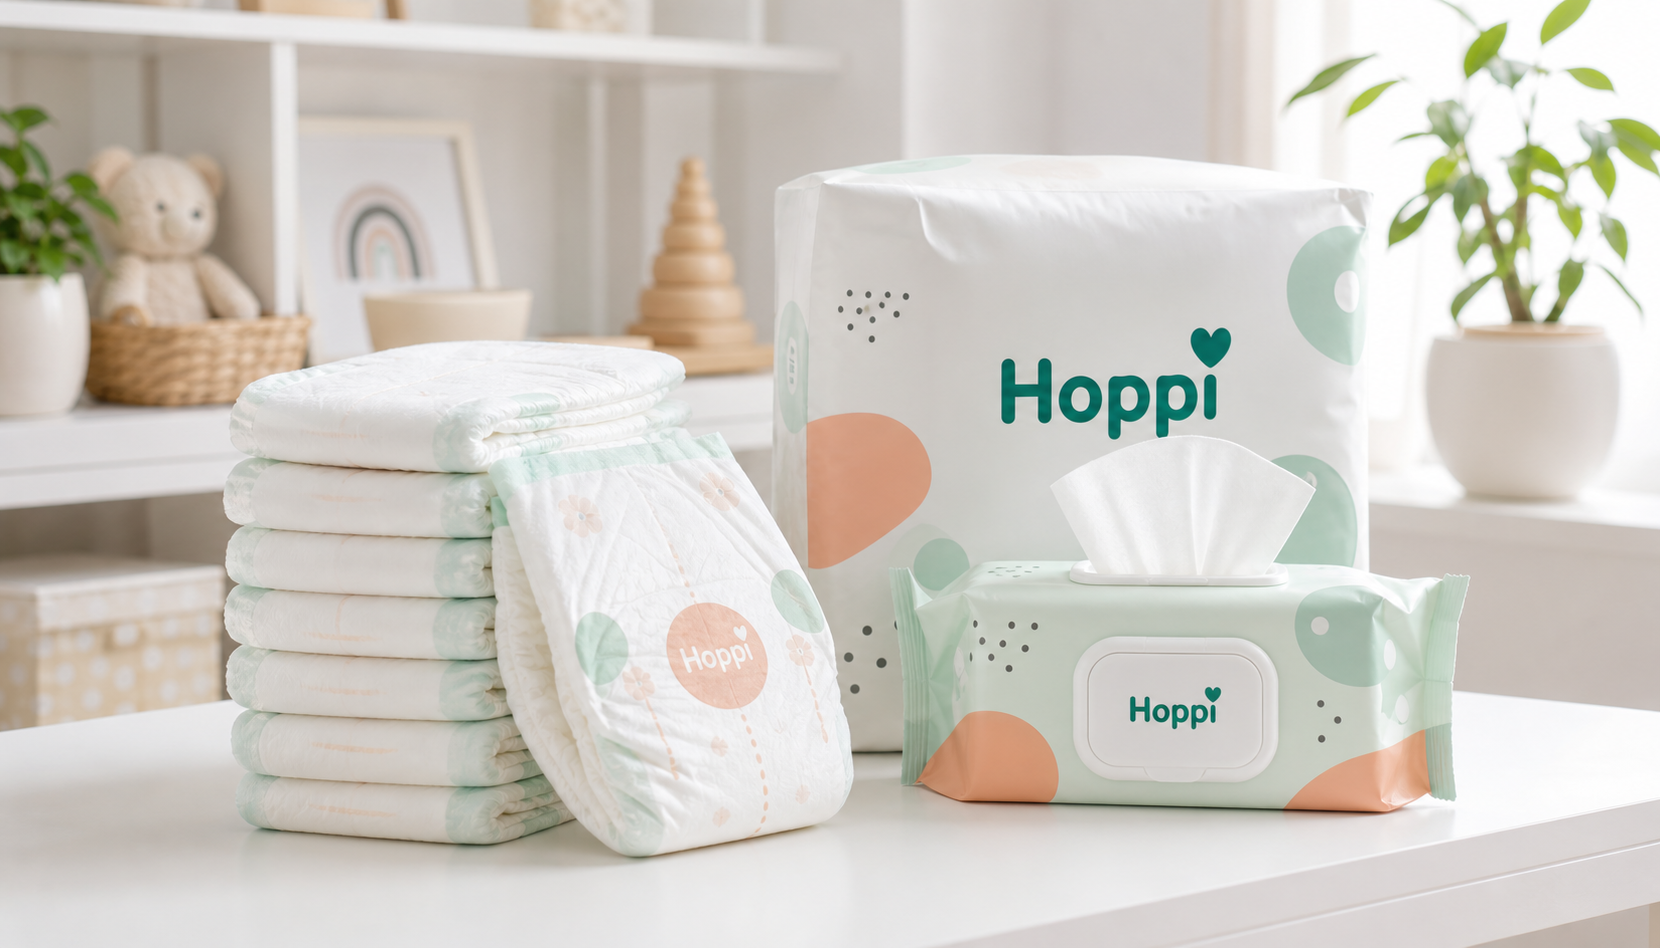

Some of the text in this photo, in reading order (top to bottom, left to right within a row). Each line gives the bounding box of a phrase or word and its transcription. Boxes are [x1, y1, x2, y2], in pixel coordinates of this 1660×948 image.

[1001, 327, 1231, 440] Hoppi
[679, 625, 754, 674] Hoppi
[1130, 687, 1221, 730] Hoppi
